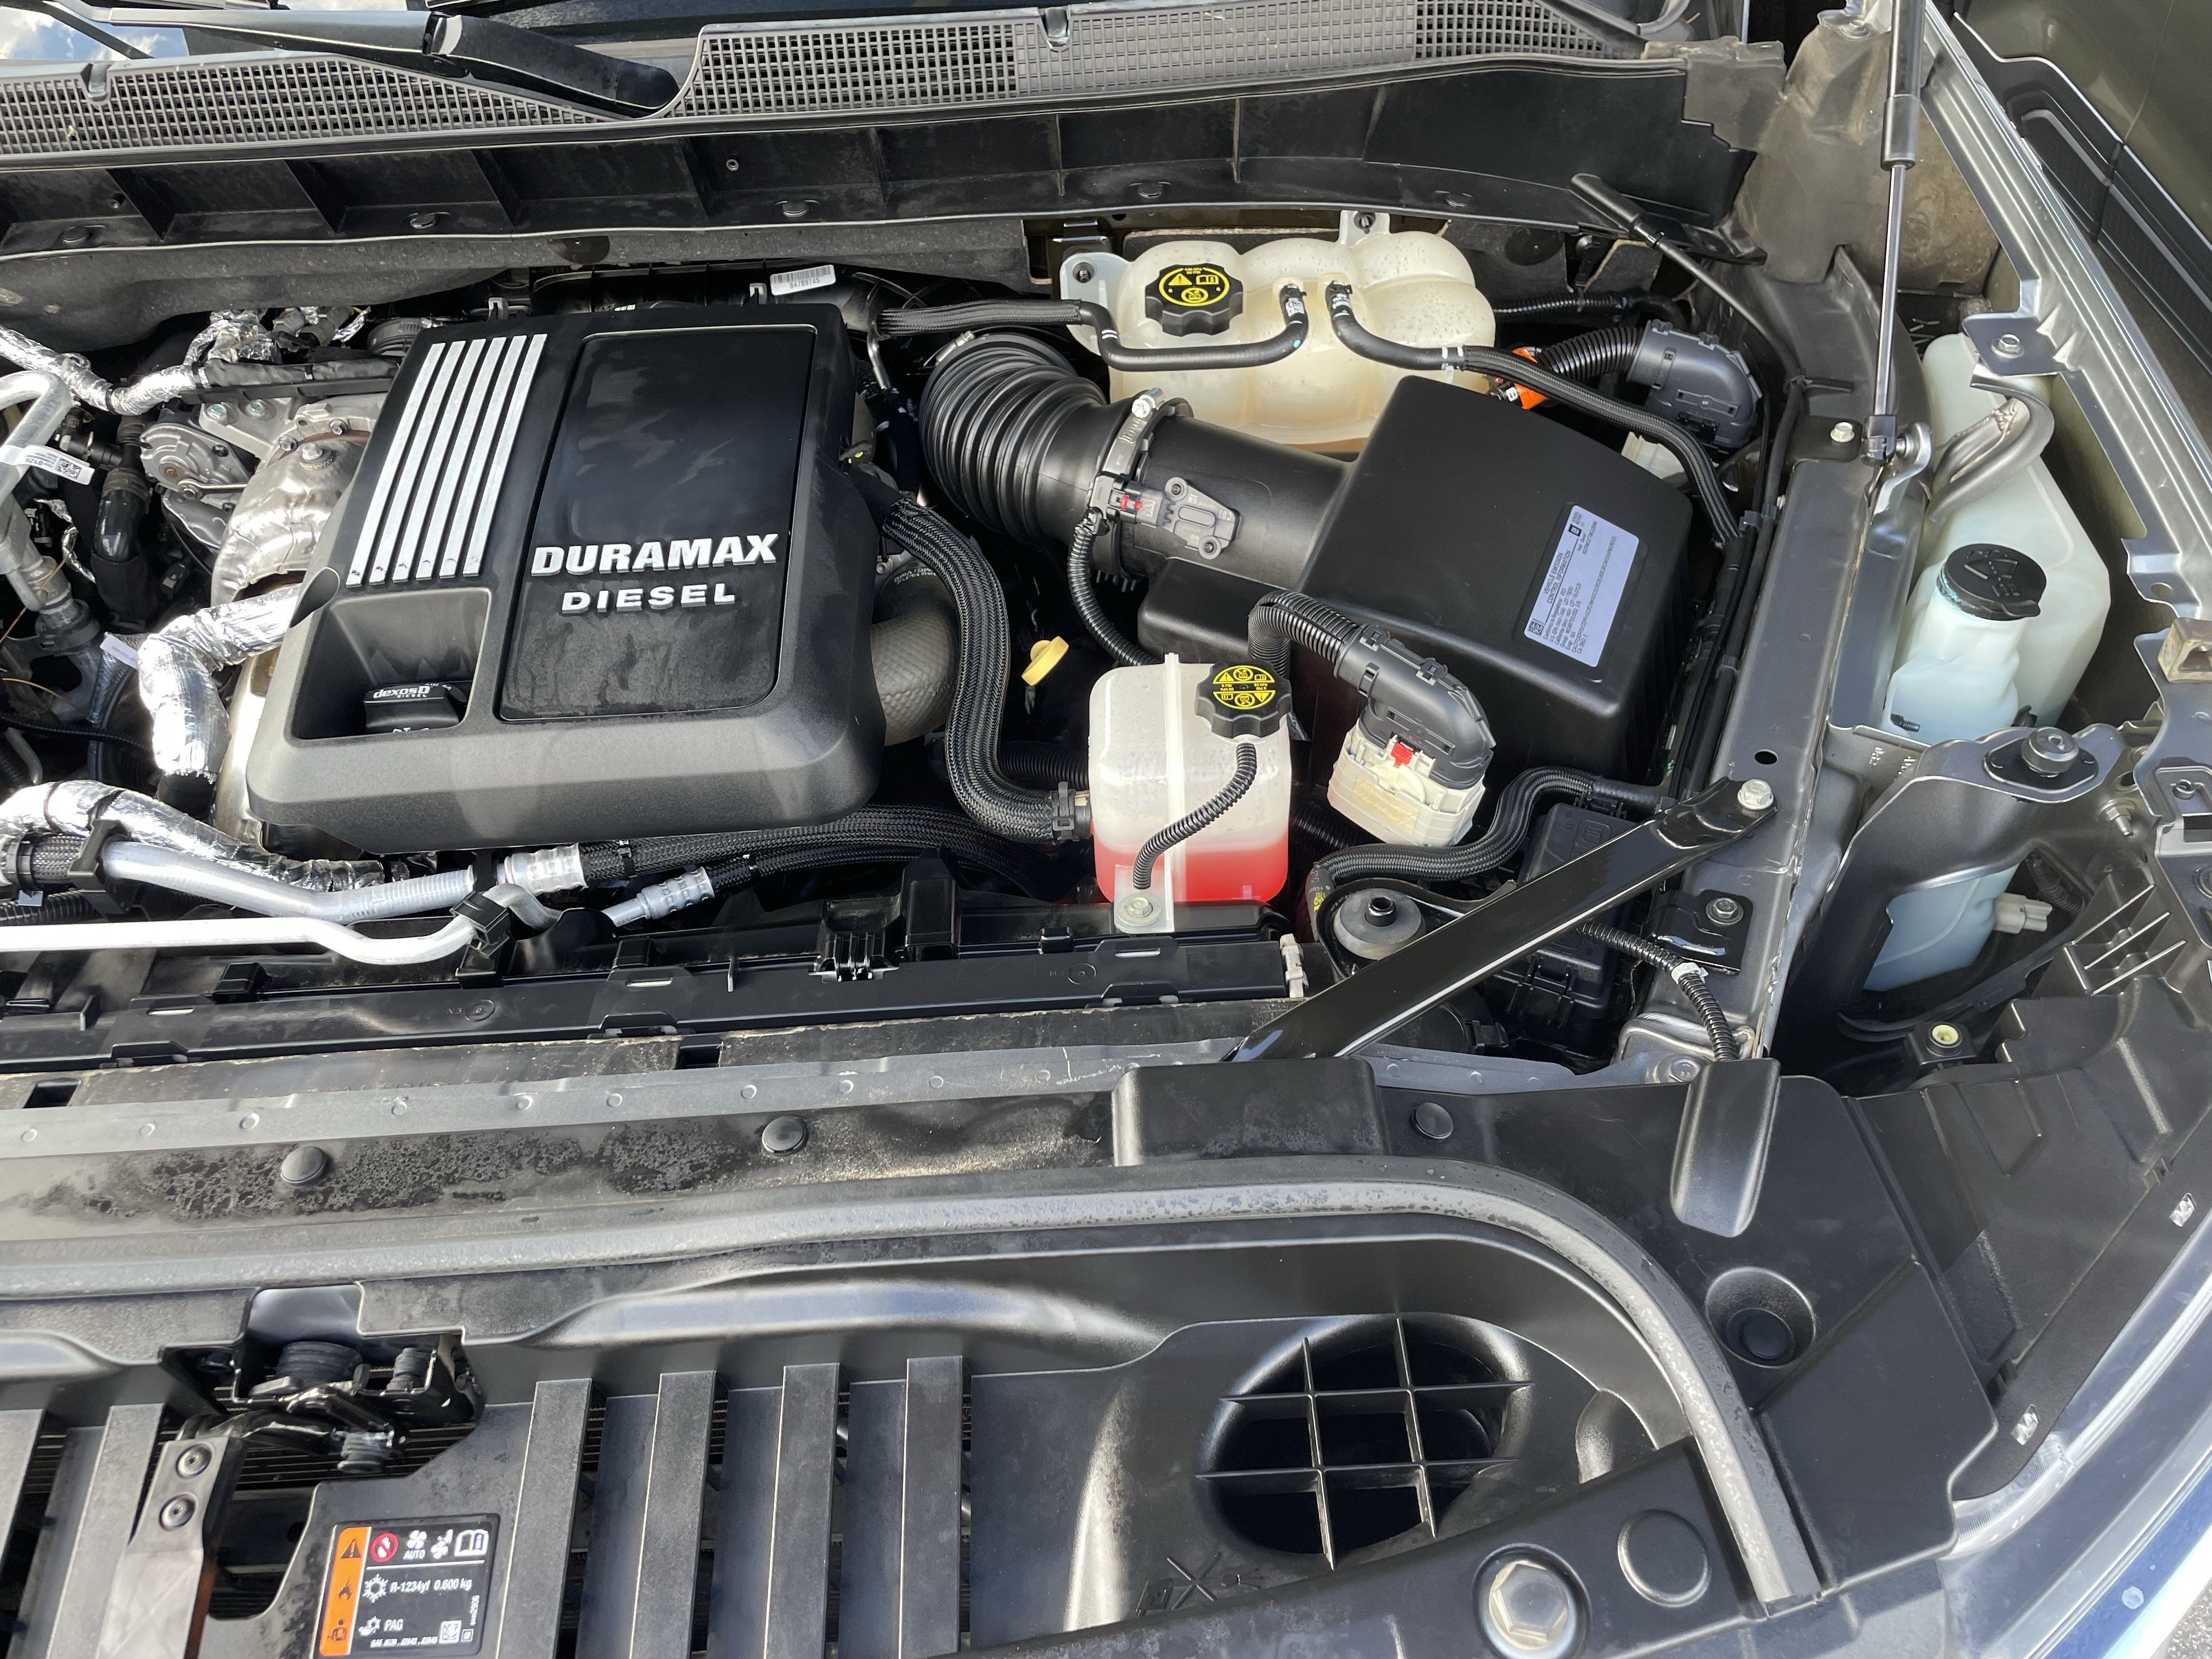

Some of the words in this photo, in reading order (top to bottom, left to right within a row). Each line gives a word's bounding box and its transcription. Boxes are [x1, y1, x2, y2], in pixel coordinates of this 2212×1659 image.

[531, 533, 778, 576] DURAMAX
[1543, 573, 1555, 594] VEHICLE
[1551, 552, 1563, 574] EMISSION
[1547, 580, 1560, 603] CONTROL
[1556, 550, 1571, 580] INFORMATION
[561, 583, 735, 614] DIESEL
[403, 1550, 425, 1560] AUTO
[433, 1579, 459, 1591] 0.600
[460, 1578, 472, 1591] kg
[383, 1619, 404, 1631] PAG
